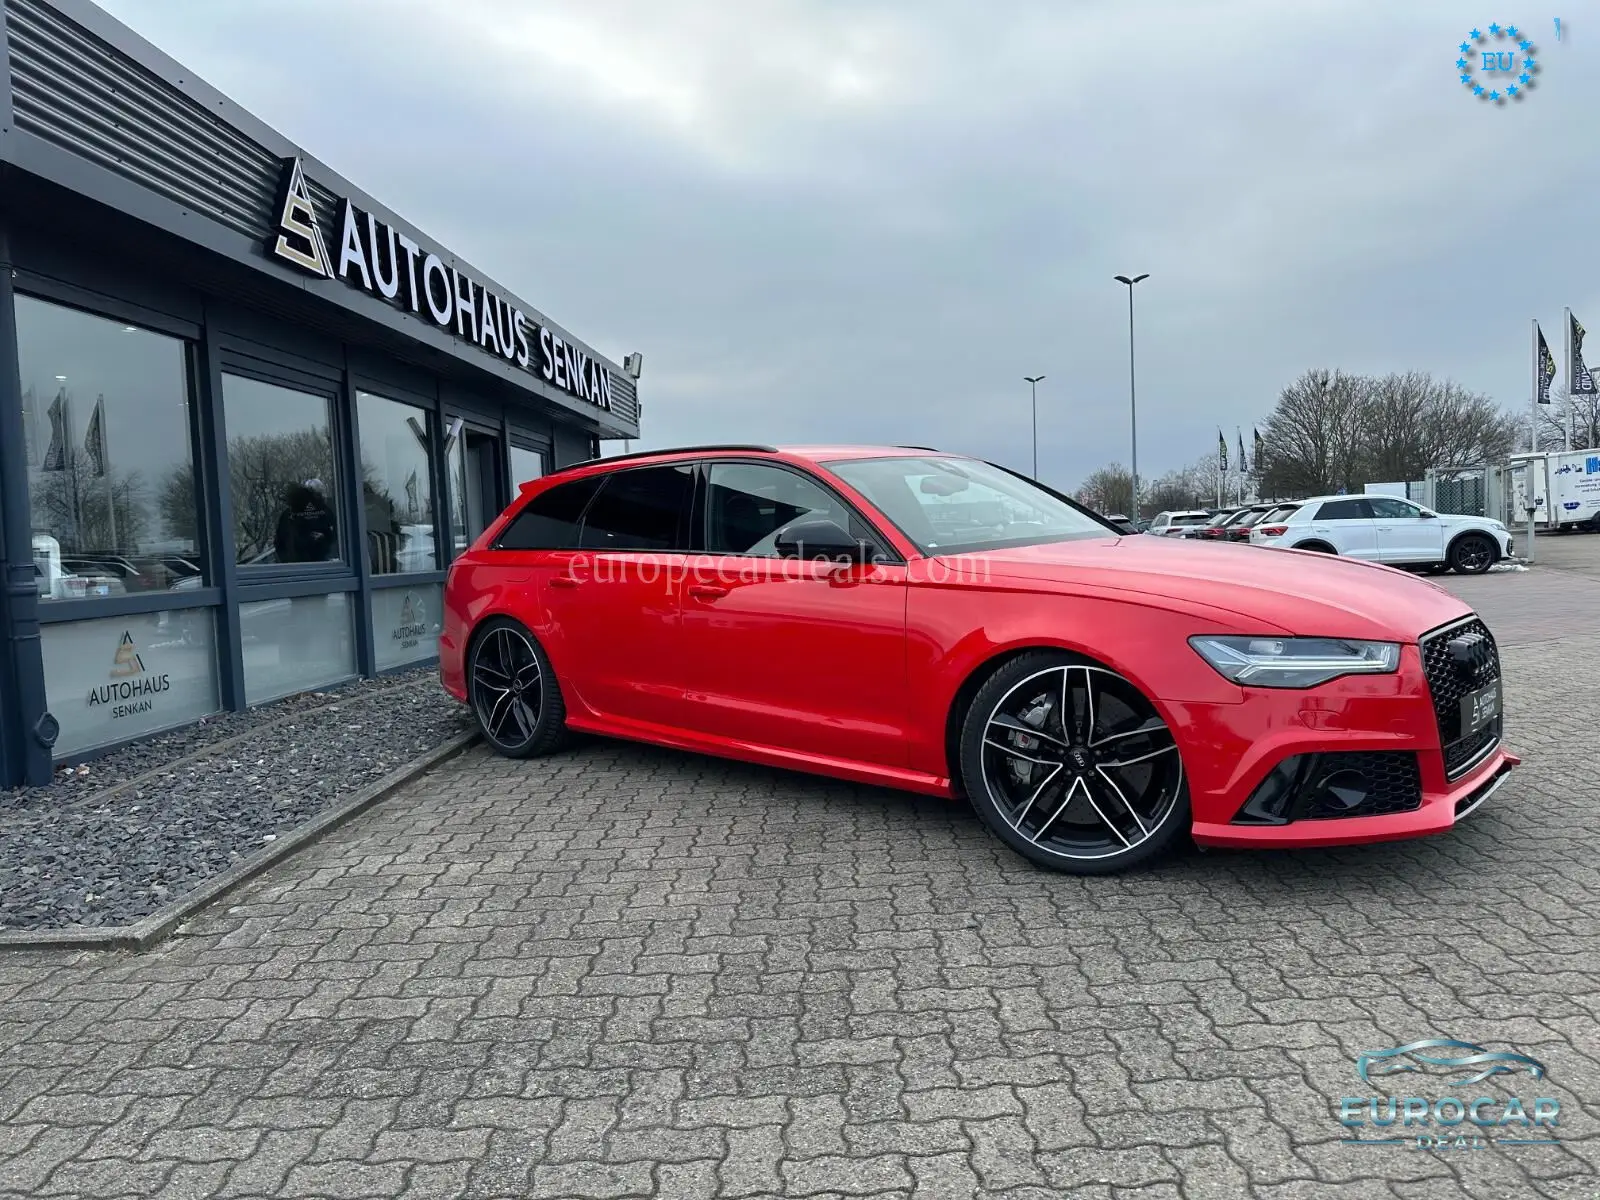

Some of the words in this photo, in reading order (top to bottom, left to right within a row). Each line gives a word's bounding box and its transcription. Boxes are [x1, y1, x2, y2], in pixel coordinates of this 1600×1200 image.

[339, 197, 529, 367] AUTOHAUS
[540, 326, 612, 412] SENKAN
[391, 623, 426, 640] AUTOHAUS
[89, 674, 170, 707] AUTOHAUS
[112, 700, 152, 719] SENKAN
